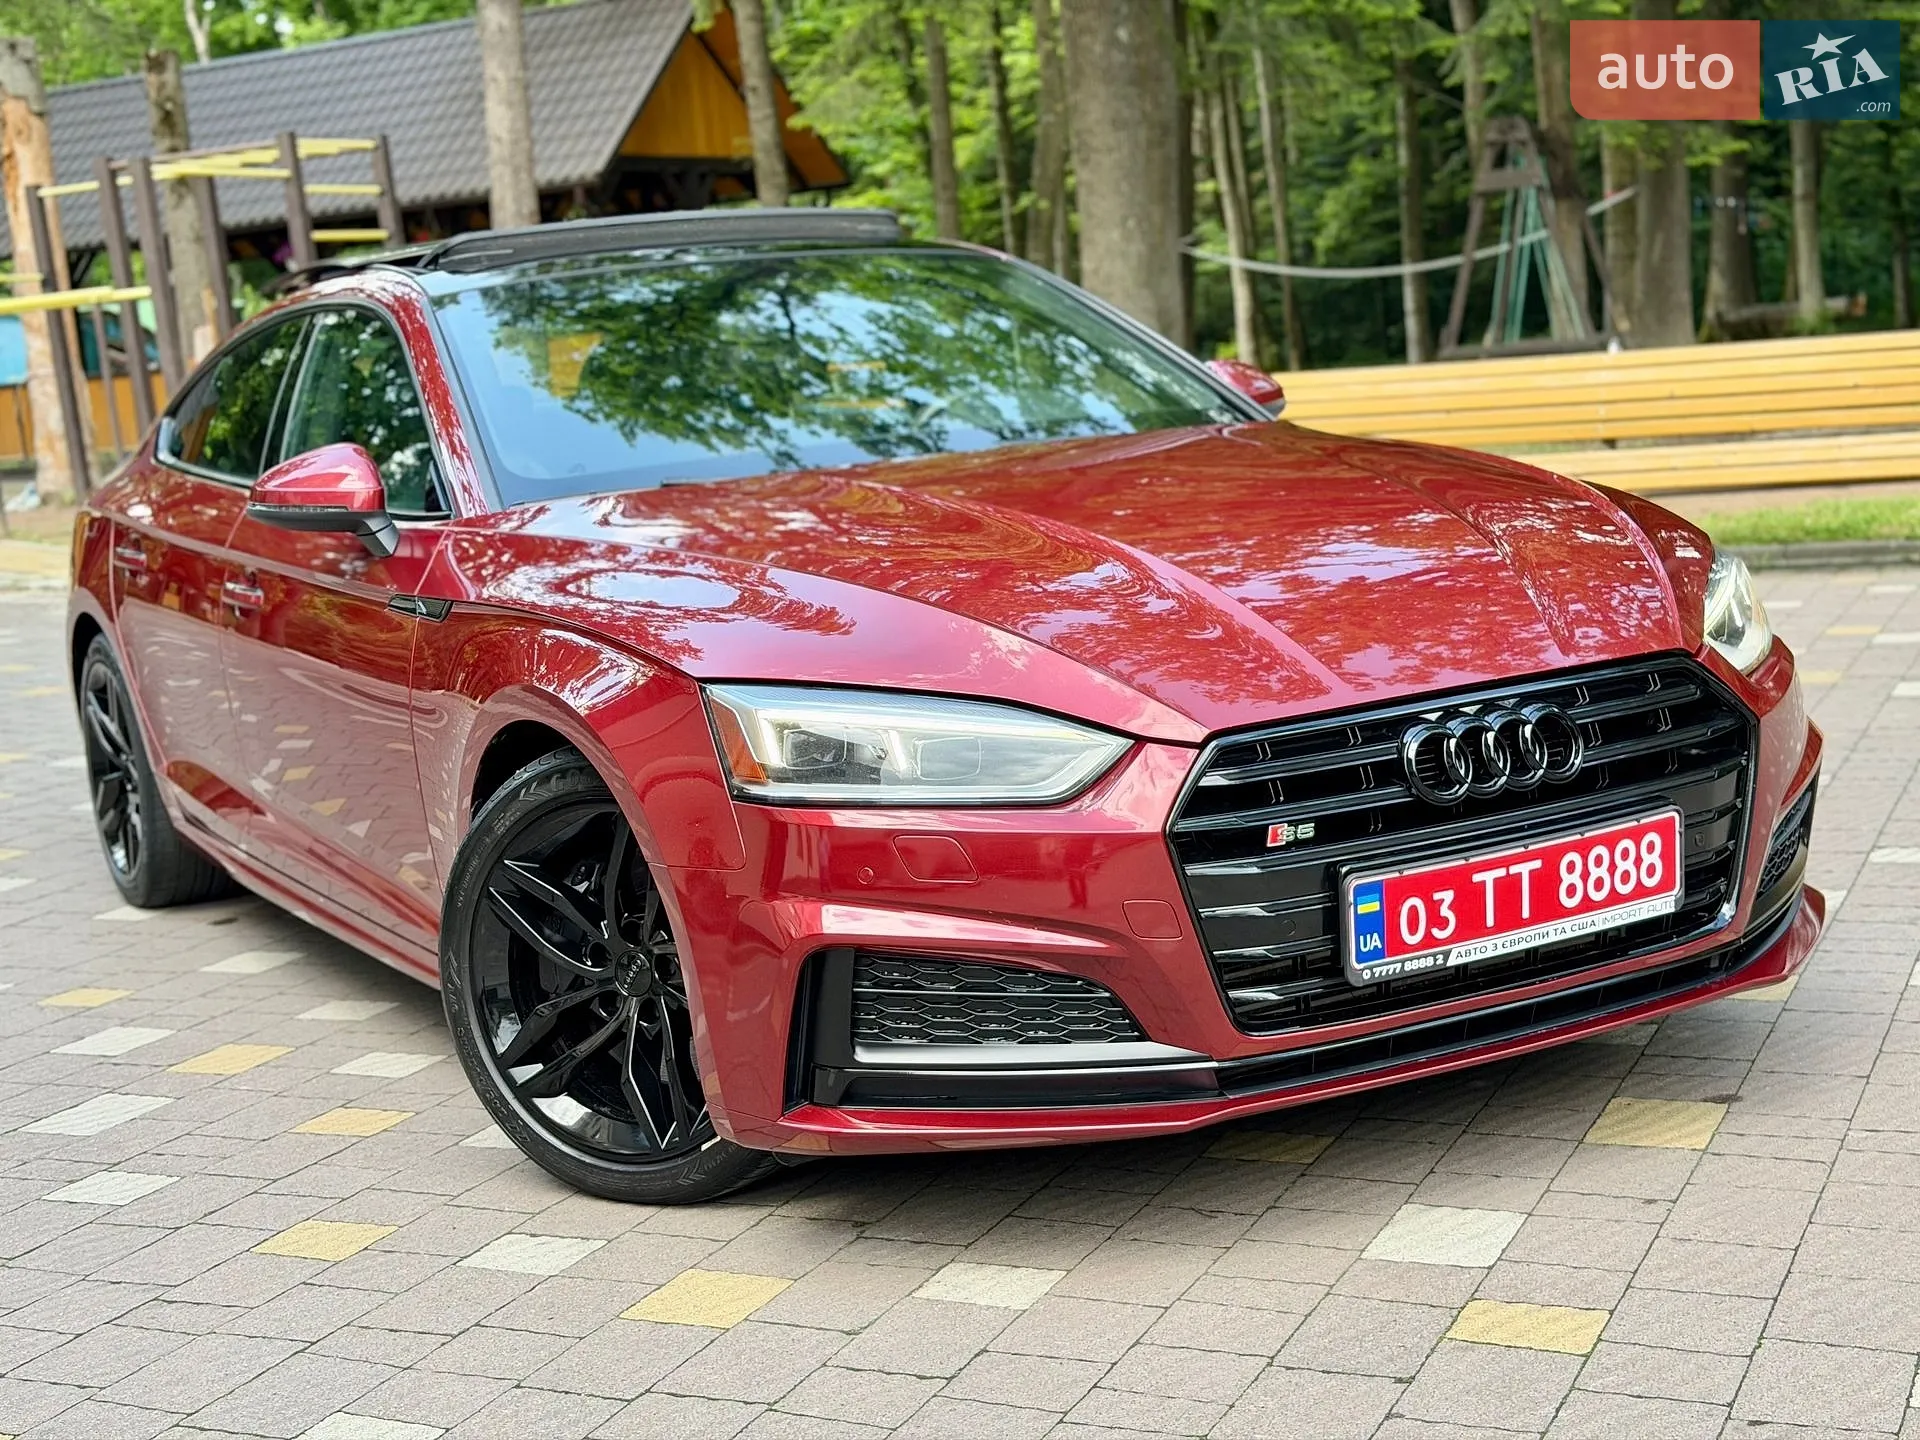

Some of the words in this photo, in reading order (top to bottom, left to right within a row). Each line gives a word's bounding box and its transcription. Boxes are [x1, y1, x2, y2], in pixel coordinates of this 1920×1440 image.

[1399, 889, 1456, 945] 03
[1472, 859, 1542, 928] TT
[1558, 832, 1663, 908] 8888
[1602, 907, 1644, 925] IMPORT
[1359, 935, 1382, 952] UA
[1455, 945, 1488, 960] АВТО
[1502, 930, 1549, 949] ЄВРОПИ
[1552, 925, 1567, 937] ТА
[1570, 919, 1596, 932] США
[1362, 969, 1371, 979] 0
[1373, 962, 1402, 977] 7777
[1404, 956, 1434, 971] 8888
[1436, 954, 1444, 965] 2
